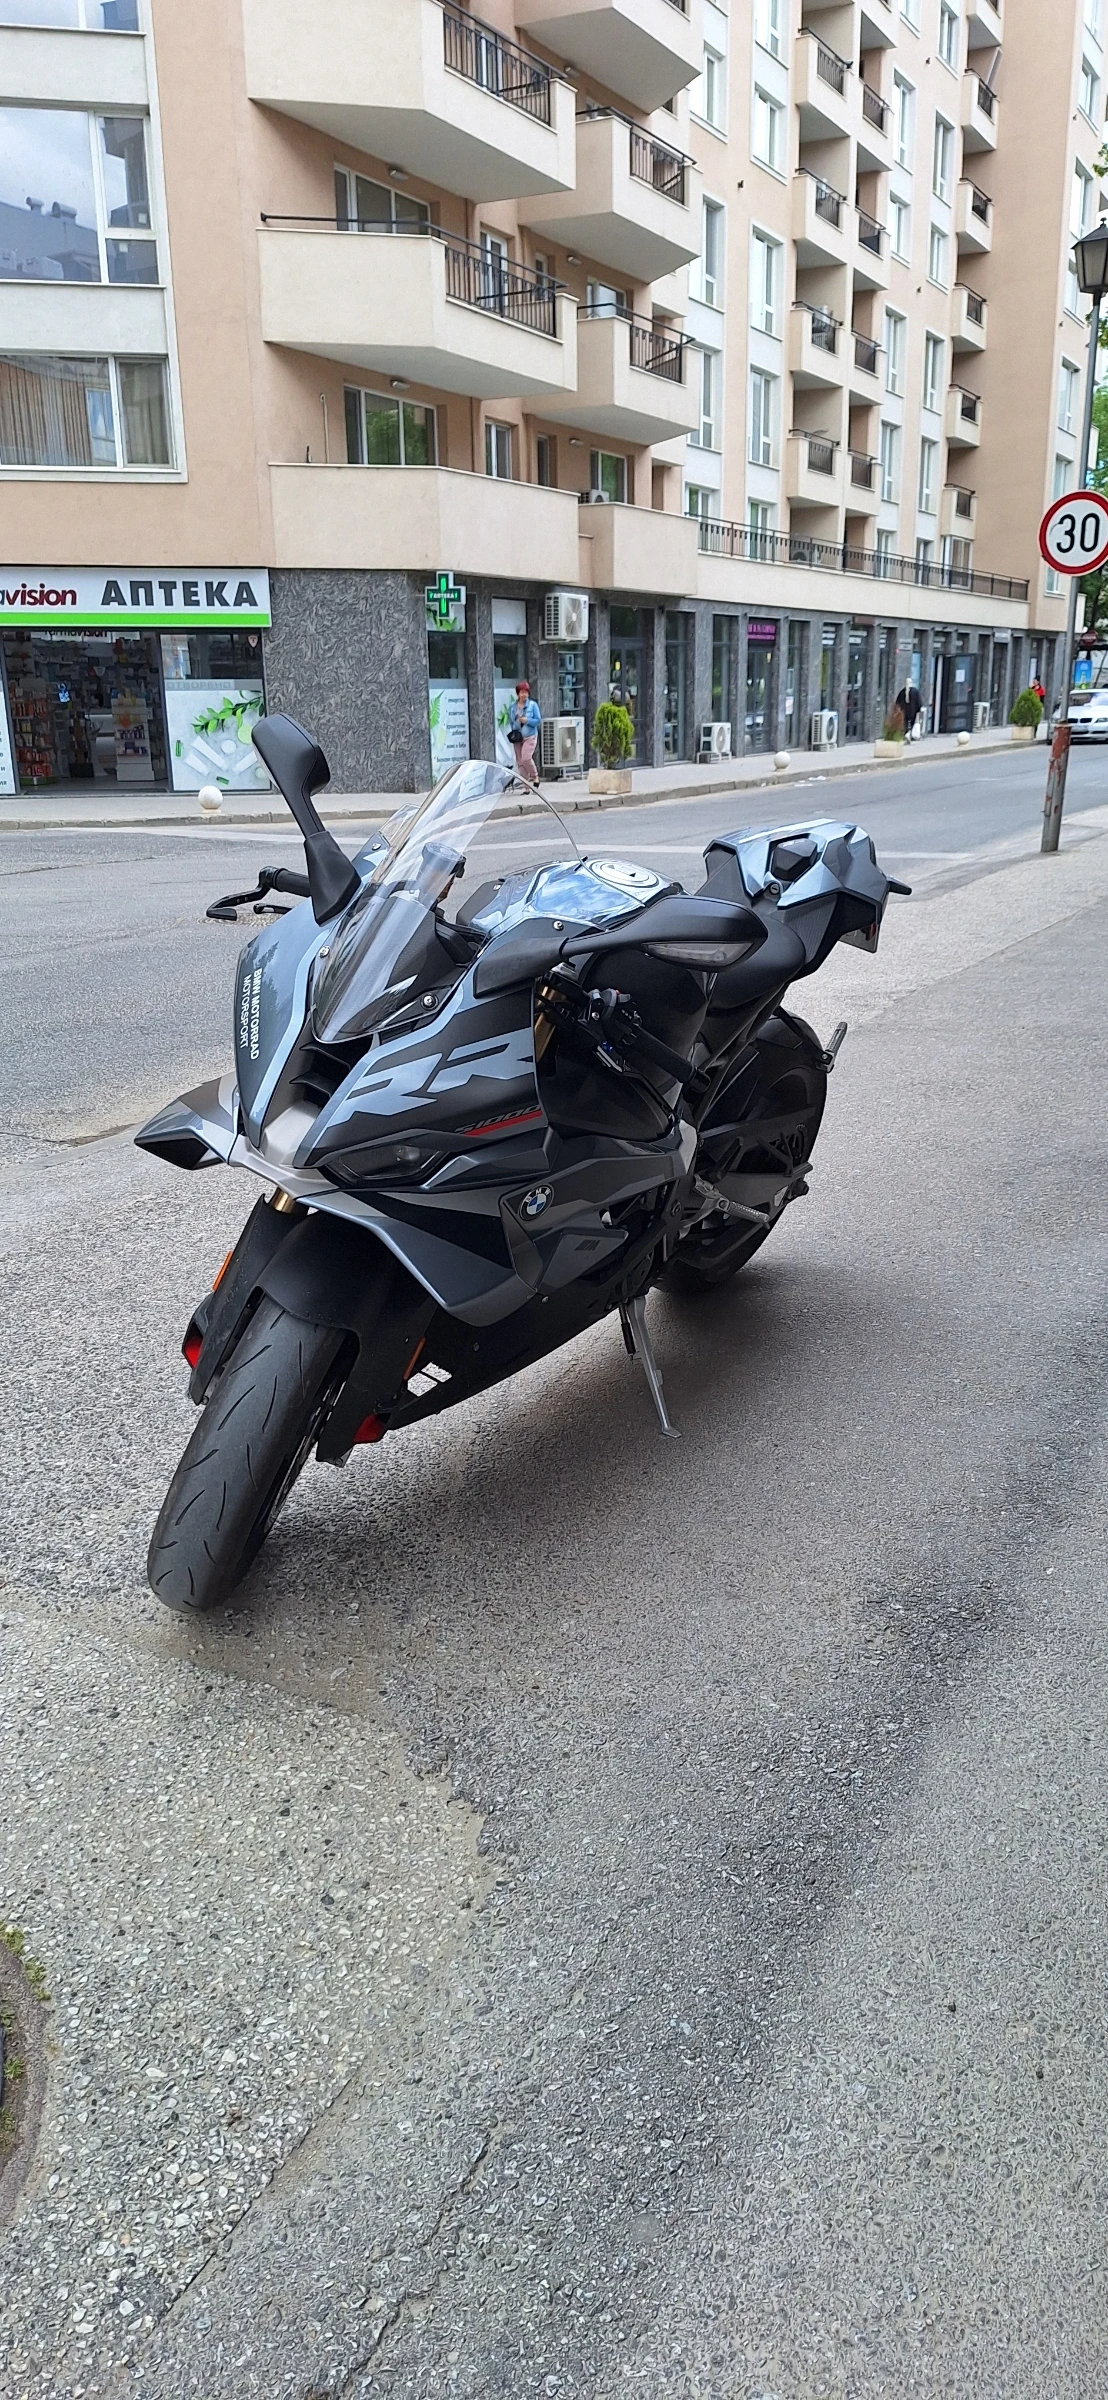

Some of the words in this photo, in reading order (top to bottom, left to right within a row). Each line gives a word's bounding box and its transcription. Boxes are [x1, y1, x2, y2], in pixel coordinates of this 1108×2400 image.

[1056, 513, 1100, 553] 30
[100, 580, 259, 607] АПТЕКА
[252, 968, 262, 994] BMW
[240, 975, 251, 1048] MOTORSPORT
[250, 995, 260, 1059] MOTORRAD
[326, 1026, 536, 1129] RR
[523, 1187, 552, 1203] BMW
